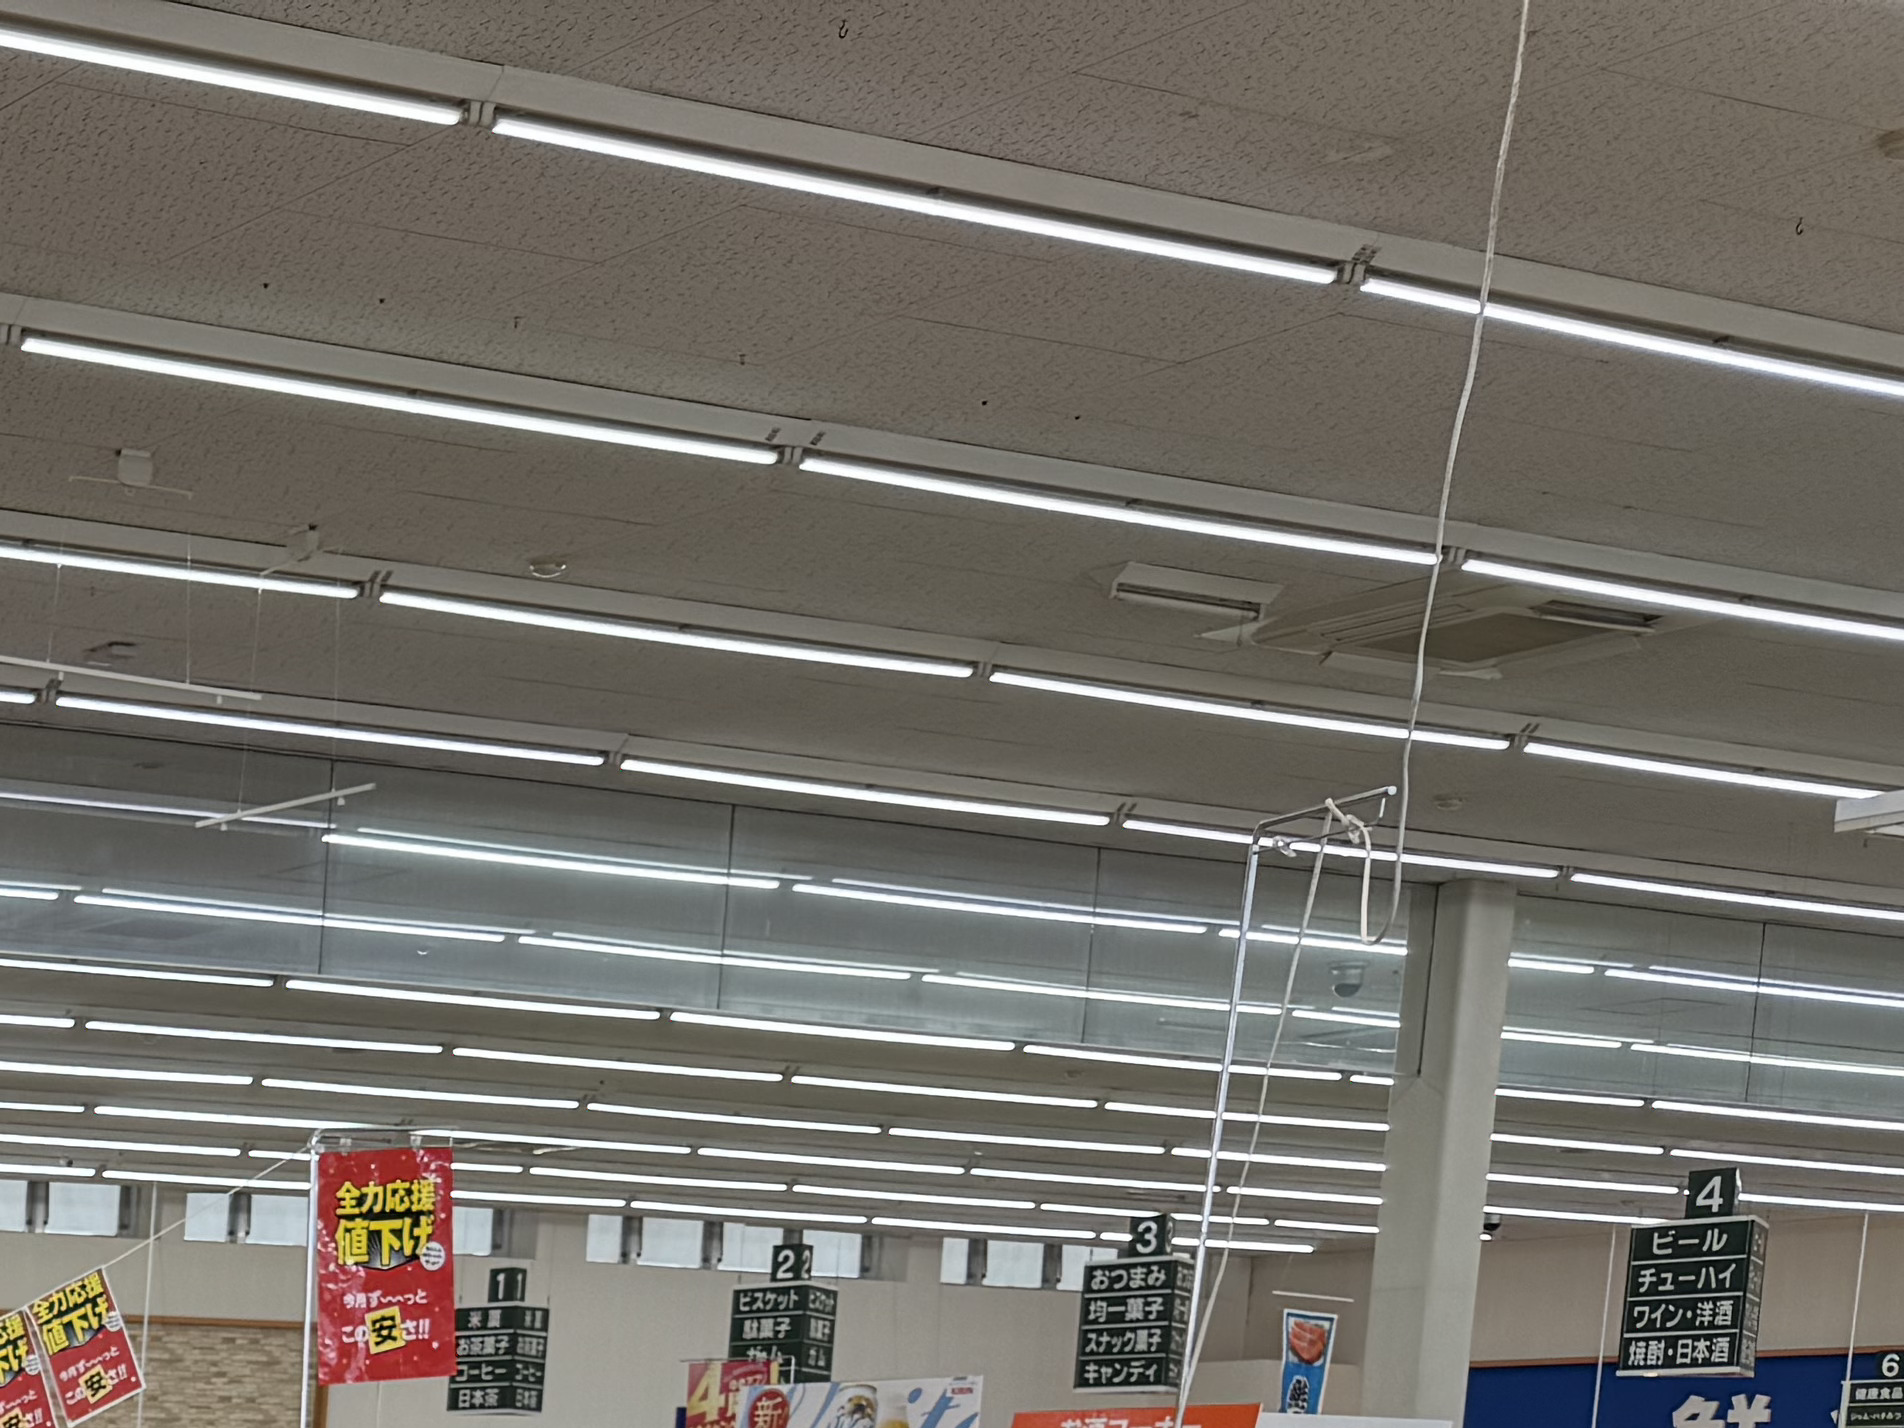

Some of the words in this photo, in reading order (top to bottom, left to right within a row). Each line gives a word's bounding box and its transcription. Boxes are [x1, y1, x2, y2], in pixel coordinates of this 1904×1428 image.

[335, 1179, 436, 1215] 全力応援
[1695, 1174, 1724, 1213] 4
[335, 1216, 434, 1266] 値下げ
[1135, 1221, 1158, 1254] 3
[1651, 1228, 1728, 1255] ビール
[777, 1250, 794, 1279] 2
[1091, 1266, 1167, 1290] おつまみ
[1637, 1263, 1738, 1294] チューハイ
[31, 1272, 104, 1324] 全力応援
[739, 1289, 799, 1311] ビスケット
[1089, 1298, 1164, 1322] 均一菓子
[41, 1298, 110, 1355] 値下げ
[743, 1317, 791, 1340] 駄菓子
[1632, 1301, 1734, 1329] ワイン・洋酒
[1084, 1330, 1162, 1354] スナック菓子
[1628, 1336, 1731, 1366] 焼酎・日本酒
[454, 1364, 507, 1382] コーヒー
[1083, 1362, 1158, 1384] キャンディ
[1881, 1353, 1900, 1377] 6
[458, 1389, 499, 1408] 日本茶
